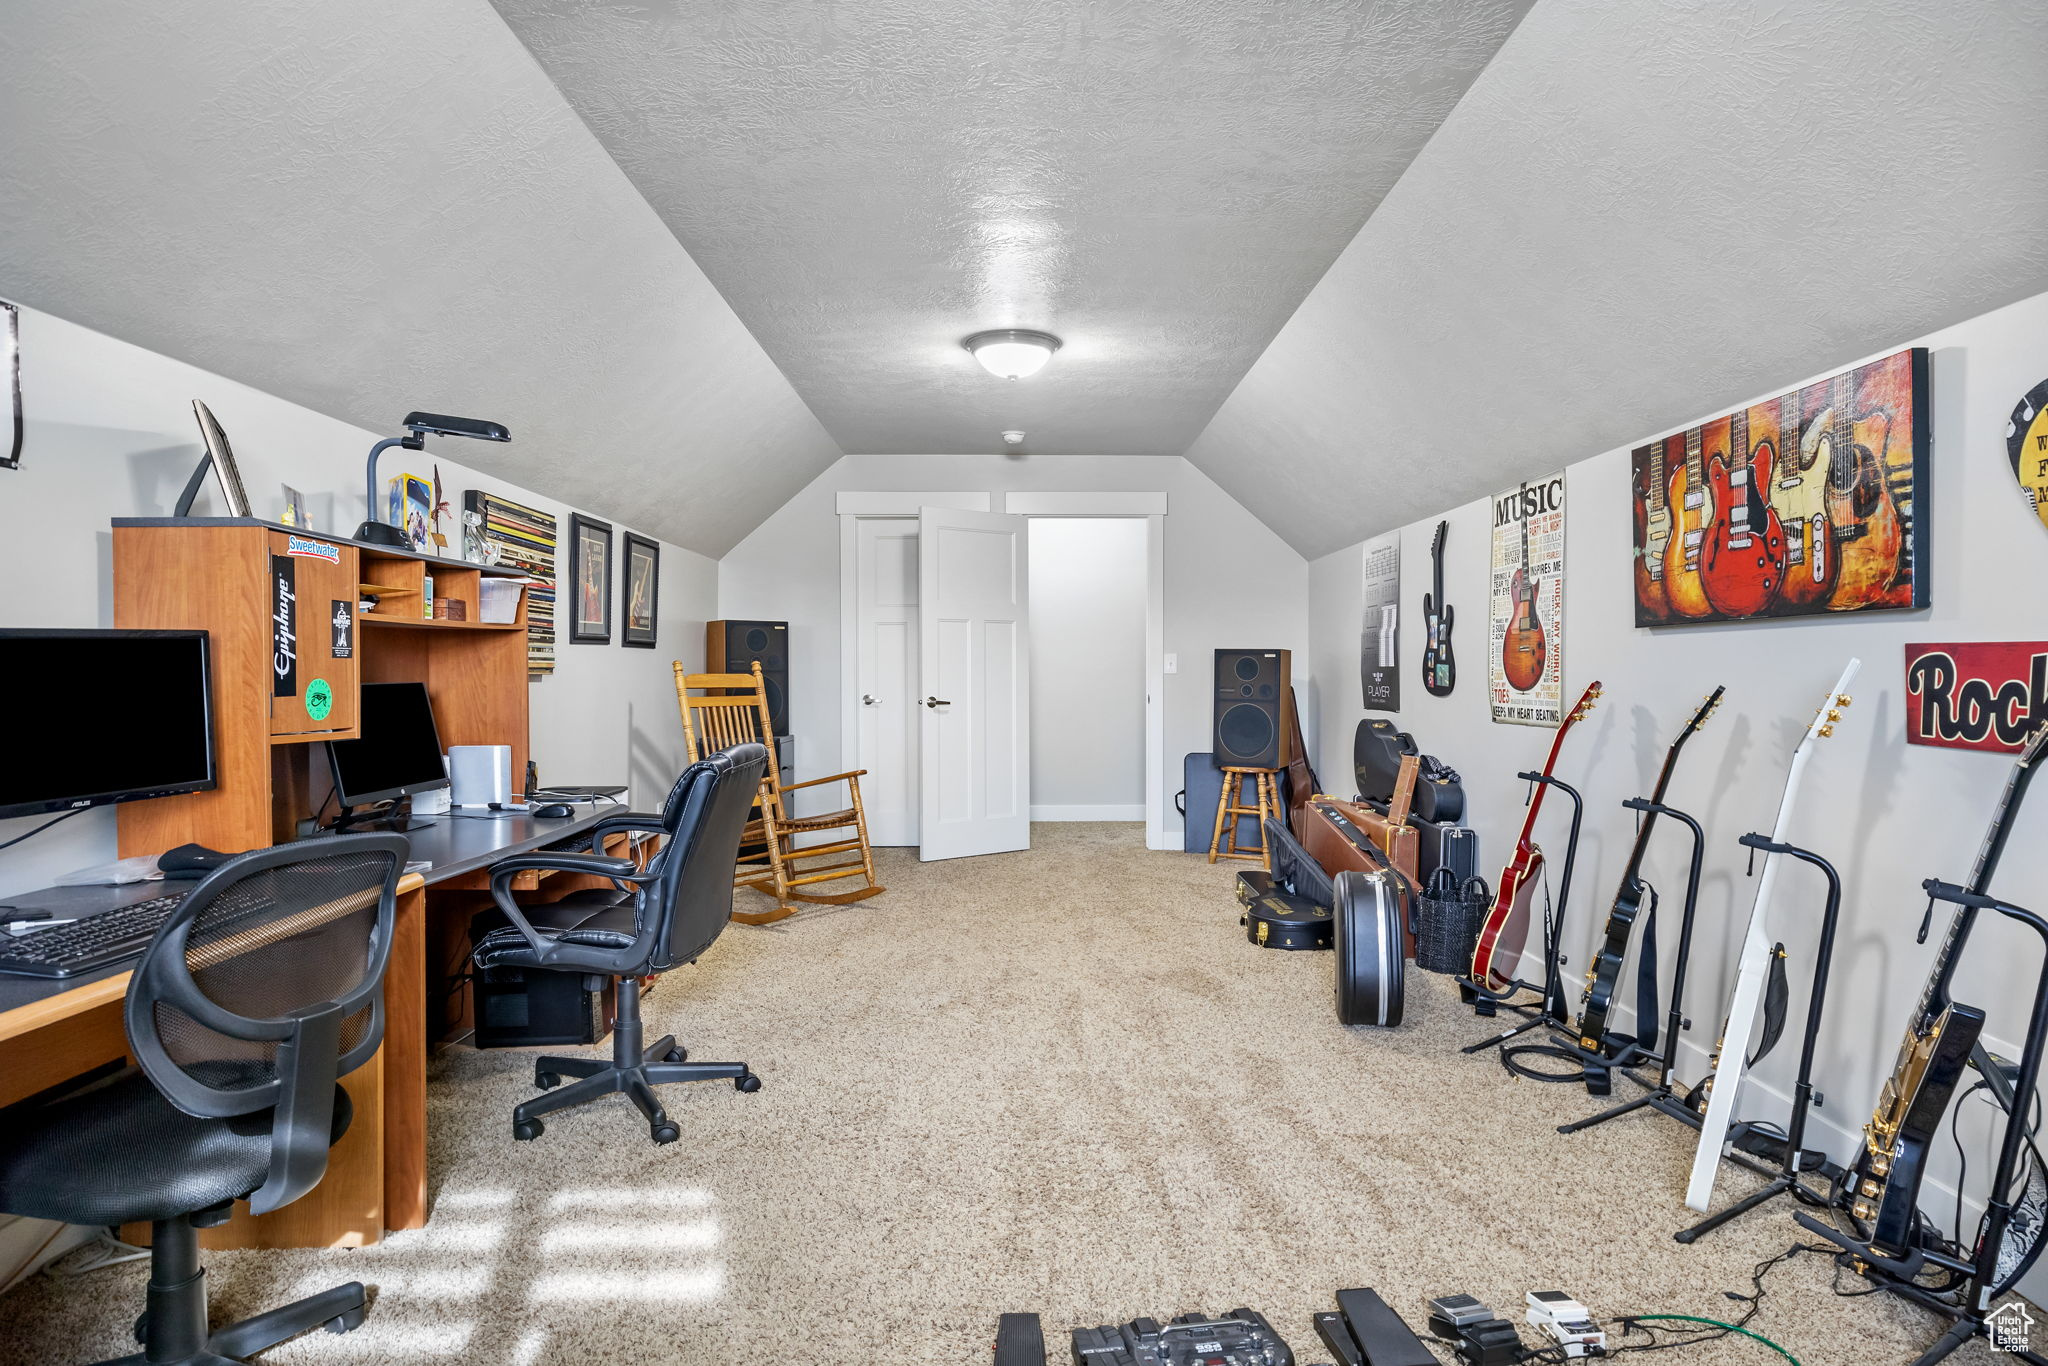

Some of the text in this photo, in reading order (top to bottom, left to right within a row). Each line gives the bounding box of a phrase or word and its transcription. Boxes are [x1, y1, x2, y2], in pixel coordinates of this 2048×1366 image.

[1495, 478, 1562, 528] MUSIC
[1529, 525, 1541, 536] PARTY
[289, 536, 338, 558] Sweetwater
[1504, 549, 1520, 558] WANTED
[1504, 555, 1520, 566] TO SAY
[1530, 562, 1551, 576] INSPIRES
[1553, 560, 1561, 572] ME
[1494, 572, 1507, 581] BRINGS
[1494, 579, 1509, 589] TEAR TO
[1493, 587, 1510, 597] MY EYE
[273, 577, 296, 680] Epiphone
[1554, 621, 1560, 638] MY
[1367, 685, 1390, 698] PLAYER
[1494, 688, 1510, 704] TOES
[1492, 705, 1559, 722] KEEPS MY HEART BEATING
[71, 800, 91, 808] ASUS
